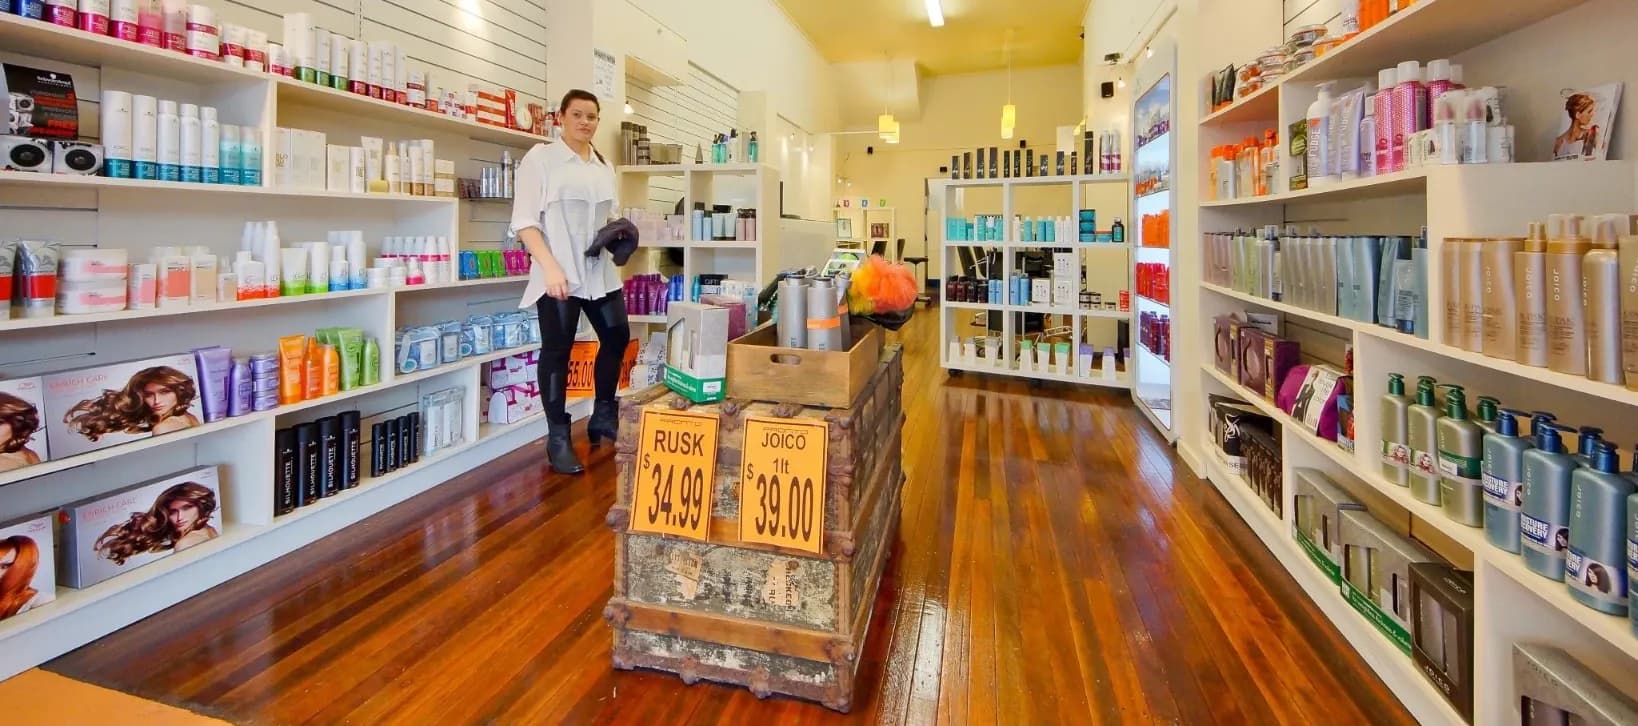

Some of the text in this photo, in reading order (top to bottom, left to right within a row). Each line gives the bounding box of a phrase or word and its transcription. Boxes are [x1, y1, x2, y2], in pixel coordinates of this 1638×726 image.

[1552, 268, 1560, 301] JOICO
[654, 429, 704, 457] RUSK
[761, 432, 806, 451] JOICO
[643, 453, 650, 470] $
[648, 463, 703, 531] 34.99
[746, 463, 753, 480] $
[755, 473, 814, 542] 39.00
